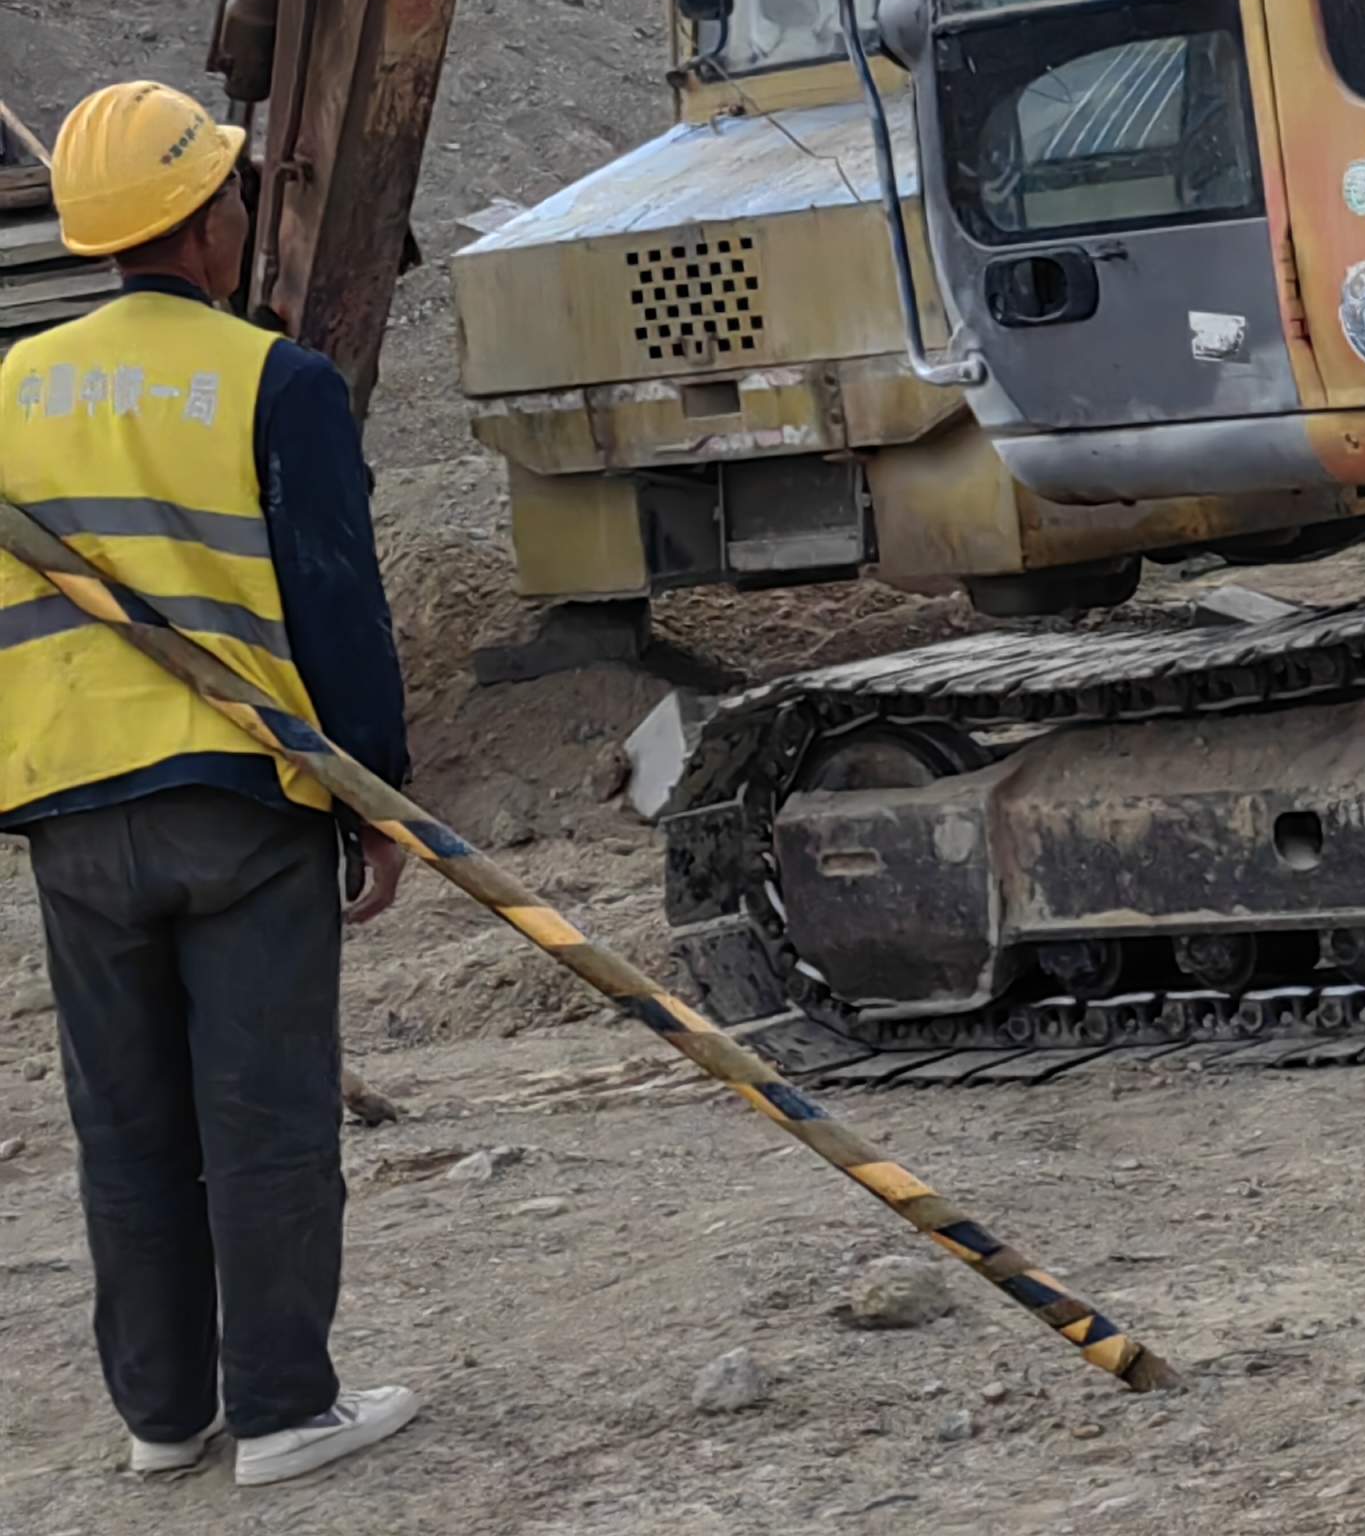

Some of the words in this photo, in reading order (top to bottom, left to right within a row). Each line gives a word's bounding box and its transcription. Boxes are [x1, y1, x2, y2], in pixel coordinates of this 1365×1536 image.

[17, 361, 221, 428] 中国中铁一局
